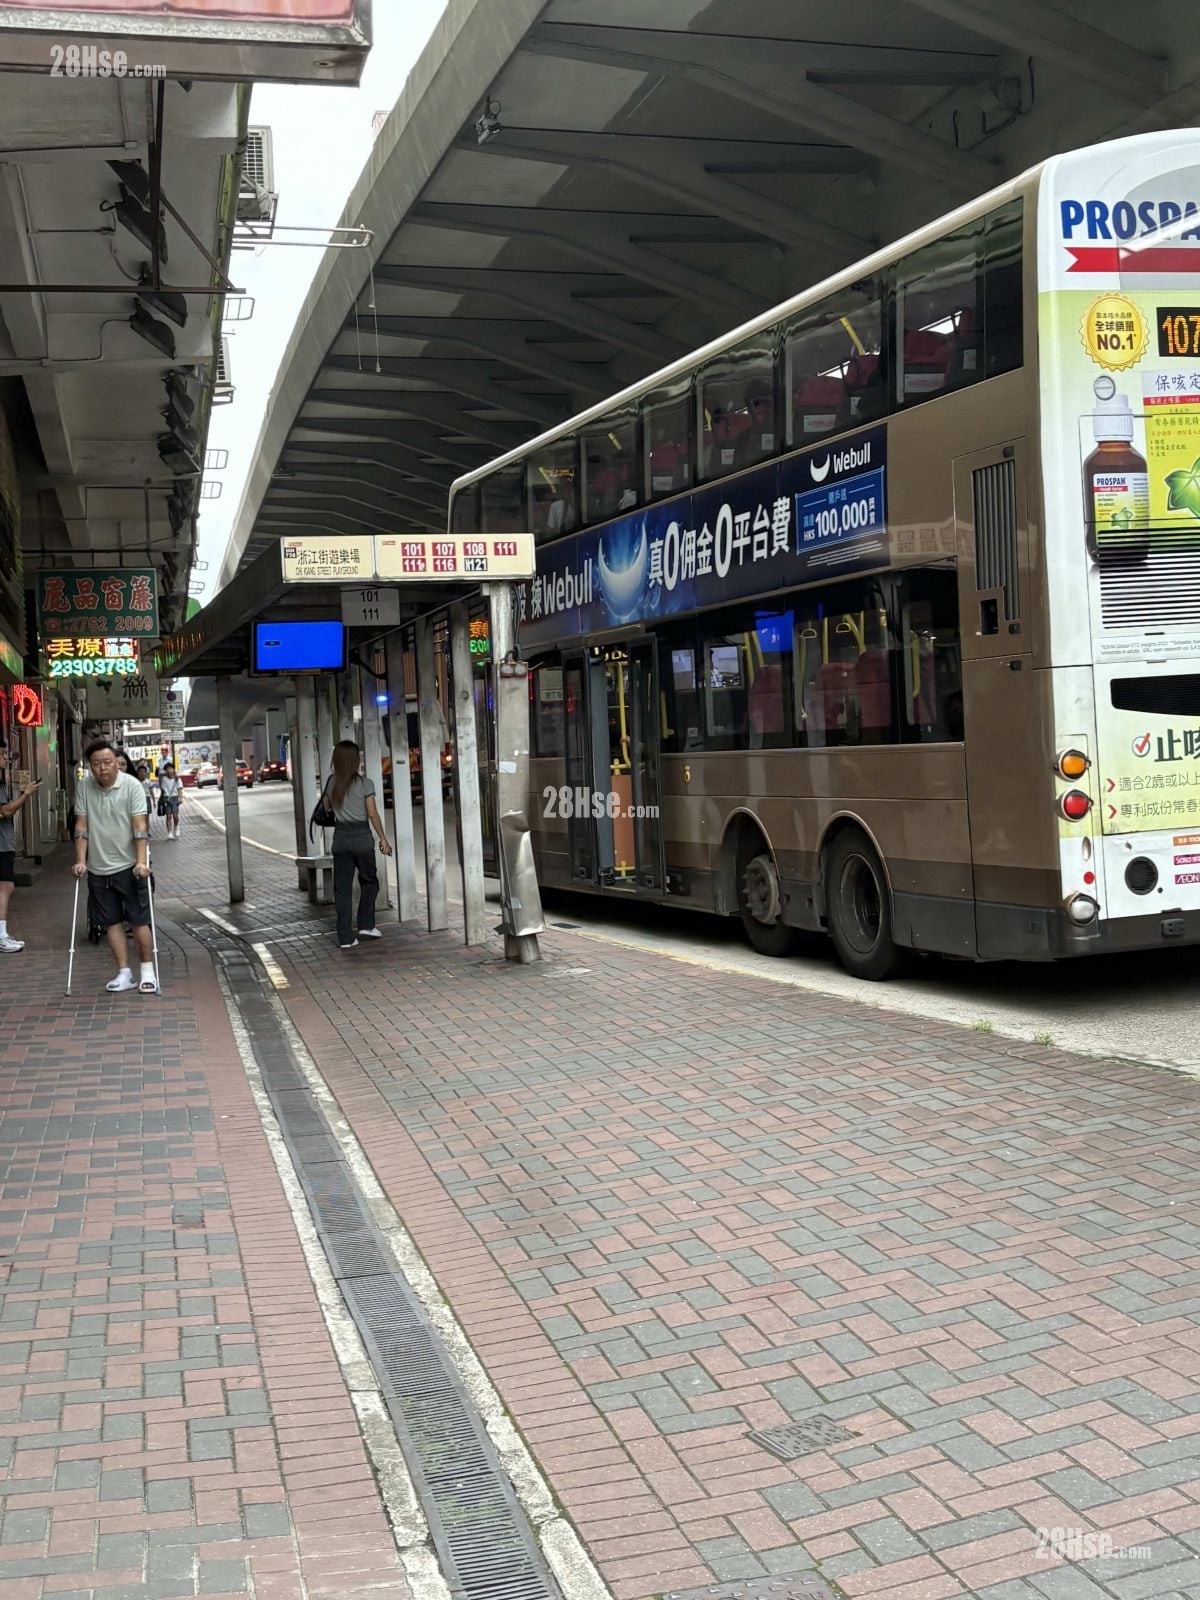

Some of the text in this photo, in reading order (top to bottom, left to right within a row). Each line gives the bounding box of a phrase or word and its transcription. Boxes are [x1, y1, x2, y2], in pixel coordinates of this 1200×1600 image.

[1061, 200, 1200, 240] PROSPA
[1162, 315, 1200, 354] 107
[1154, 373, 1200, 391] 保咳定
[833, 442, 871, 474] Webull
[816, 499, 868, 537] 100,000
[297, 548, 361, 566] 浙江街遊樂場
[404, 543, 515, 556] 101 107 108 111
[317, 566, 332, 575] STREET
[435, 559, 454, 571] 116
[360, 591, 379, 602] 101
[362, 608, 380, 620] 111
[1119, 773, 1200, 792] 適合2歲或以上
[1121, 800, 1200, 818] 專利成份常春
